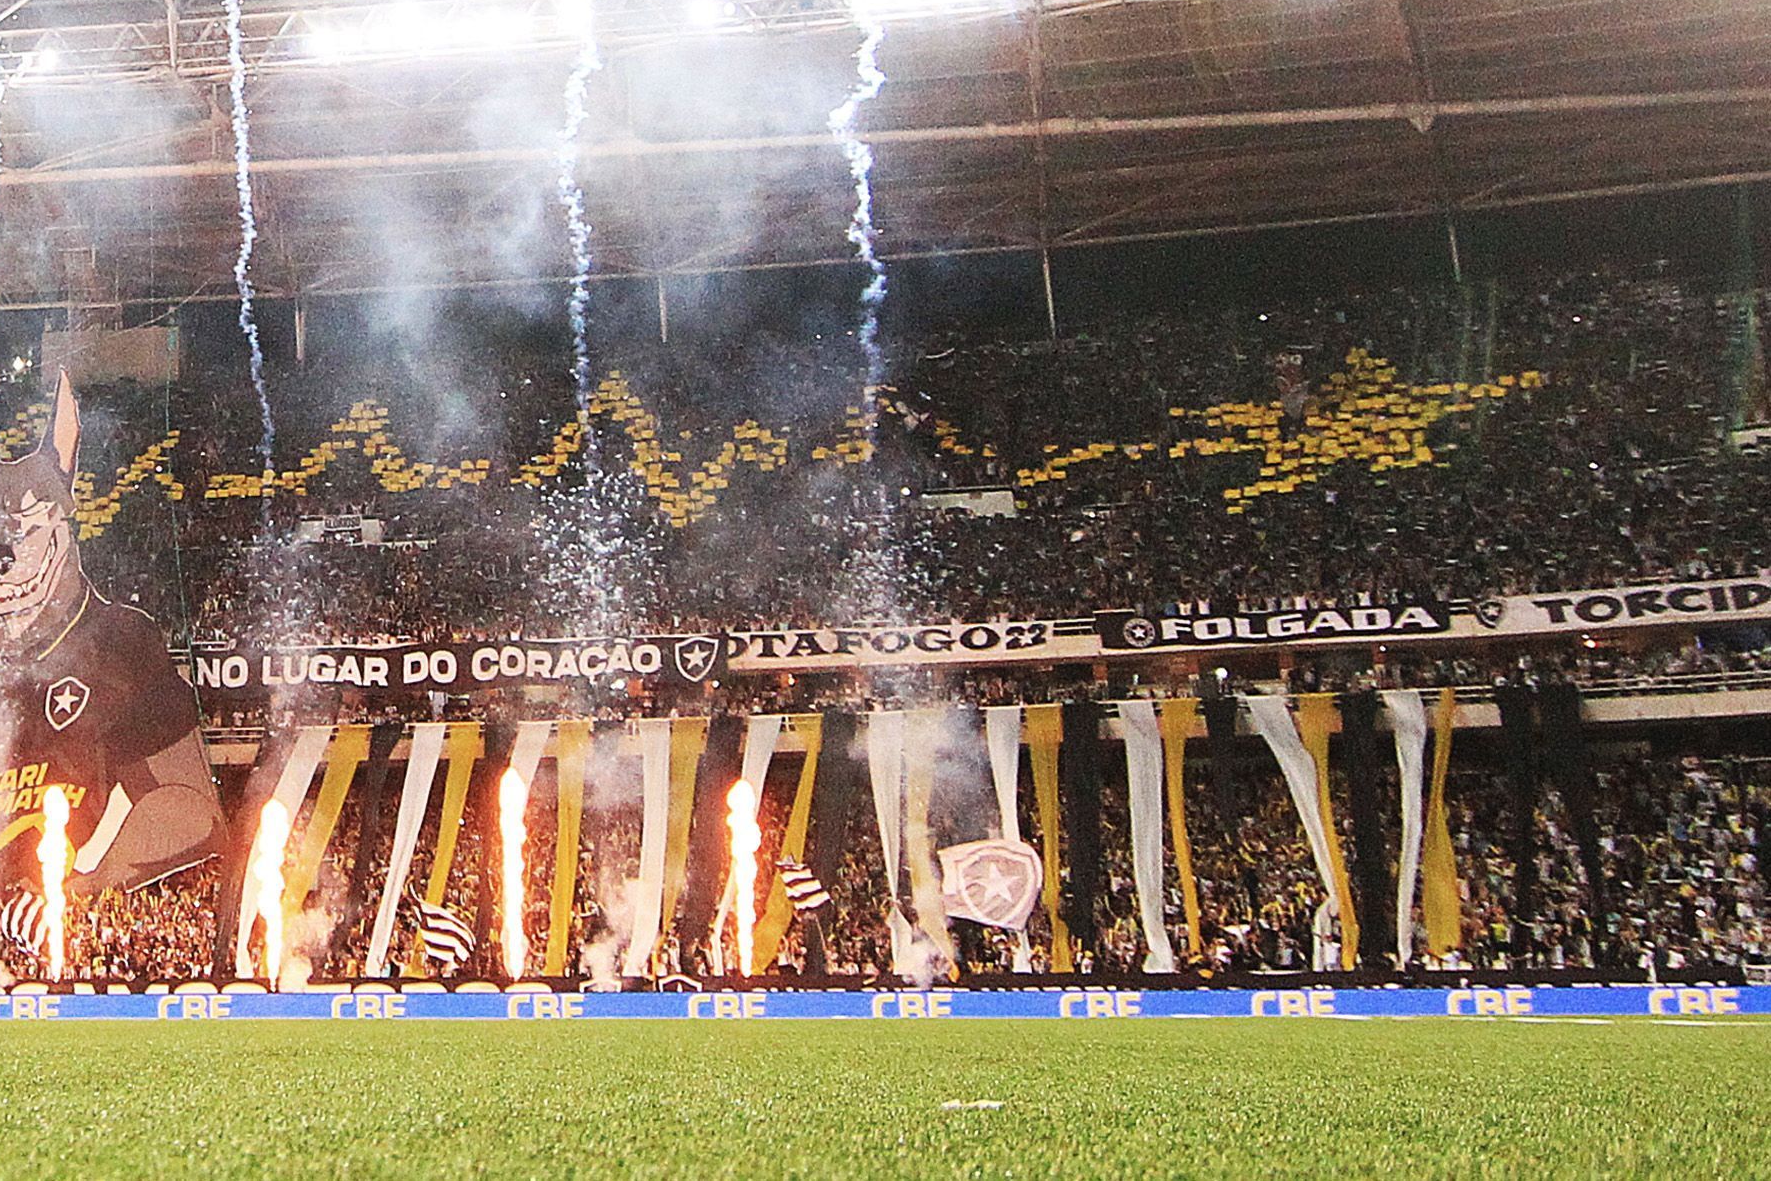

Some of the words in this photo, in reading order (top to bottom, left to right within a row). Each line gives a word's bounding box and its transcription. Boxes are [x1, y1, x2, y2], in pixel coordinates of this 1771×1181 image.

[1160, 607, 1440, 640] FOLGADA
[196, 656, 249, 688] NO
[262, 654, 388, 687] LUGAR
[403, 651, 457, 684] DO
[472, 638, 663, 683] CORAÇÃO
